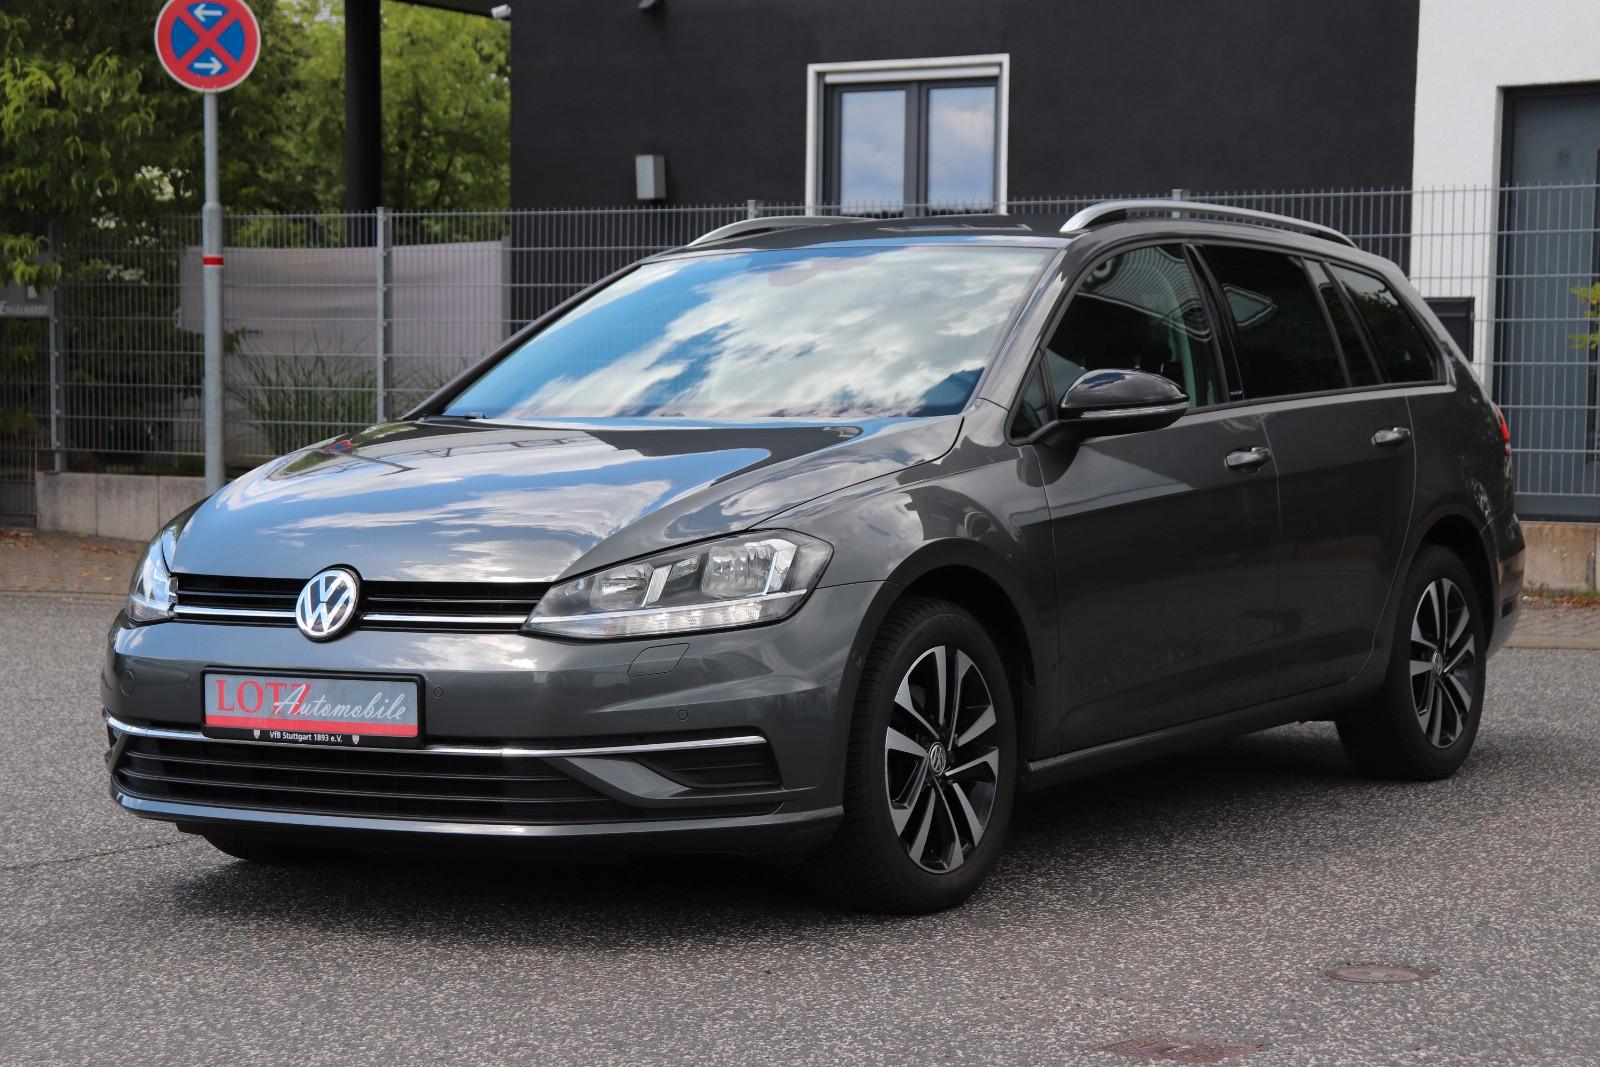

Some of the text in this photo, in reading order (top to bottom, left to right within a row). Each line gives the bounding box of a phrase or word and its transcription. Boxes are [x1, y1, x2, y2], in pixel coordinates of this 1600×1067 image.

[297, 571, 356, 636] VW
[215, 679, 406, 720] LOTZ Automobile
[269, 730, 343, 743] VfB Stuttgart 1893 e.V.
